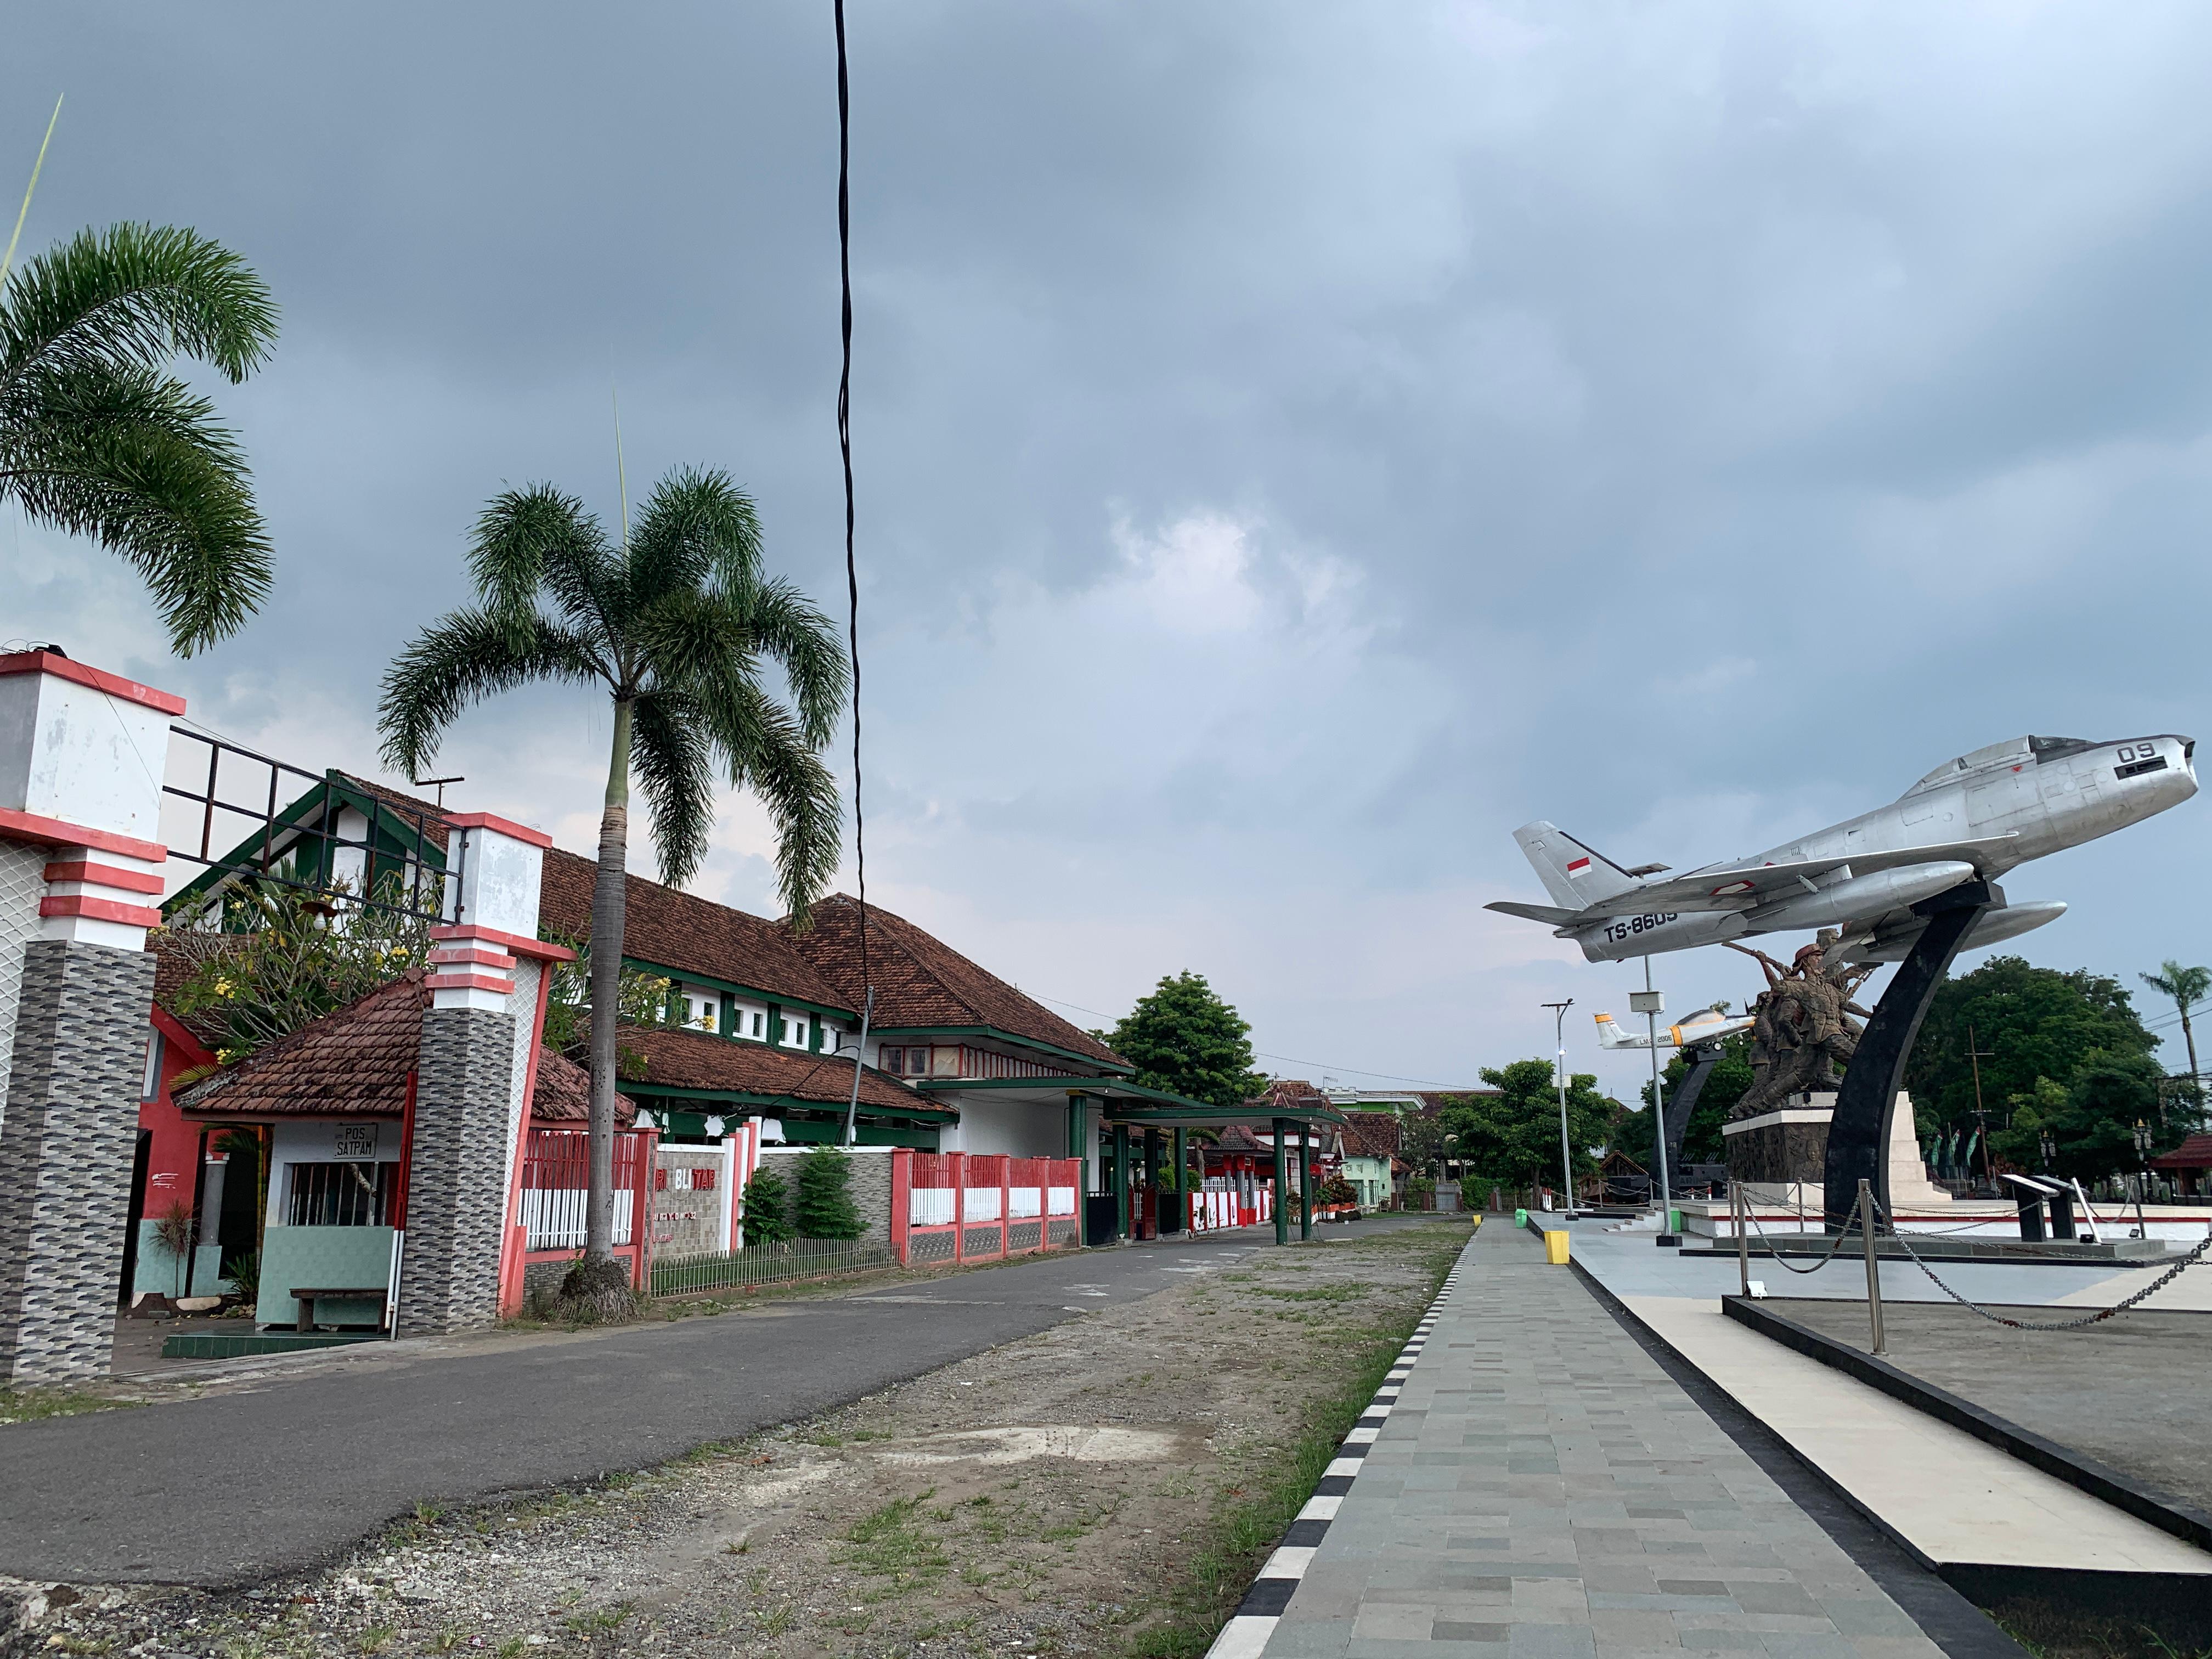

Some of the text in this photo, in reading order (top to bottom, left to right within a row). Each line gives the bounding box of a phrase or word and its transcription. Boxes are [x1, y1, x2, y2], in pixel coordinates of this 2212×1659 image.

[2117, 743, 2155, 763] 09
[346, 1127, 365, 1139] POS
[337, 1141, 372, 1155] SATPAM
[656, 1169, 715, 1191] RI BLITAR
